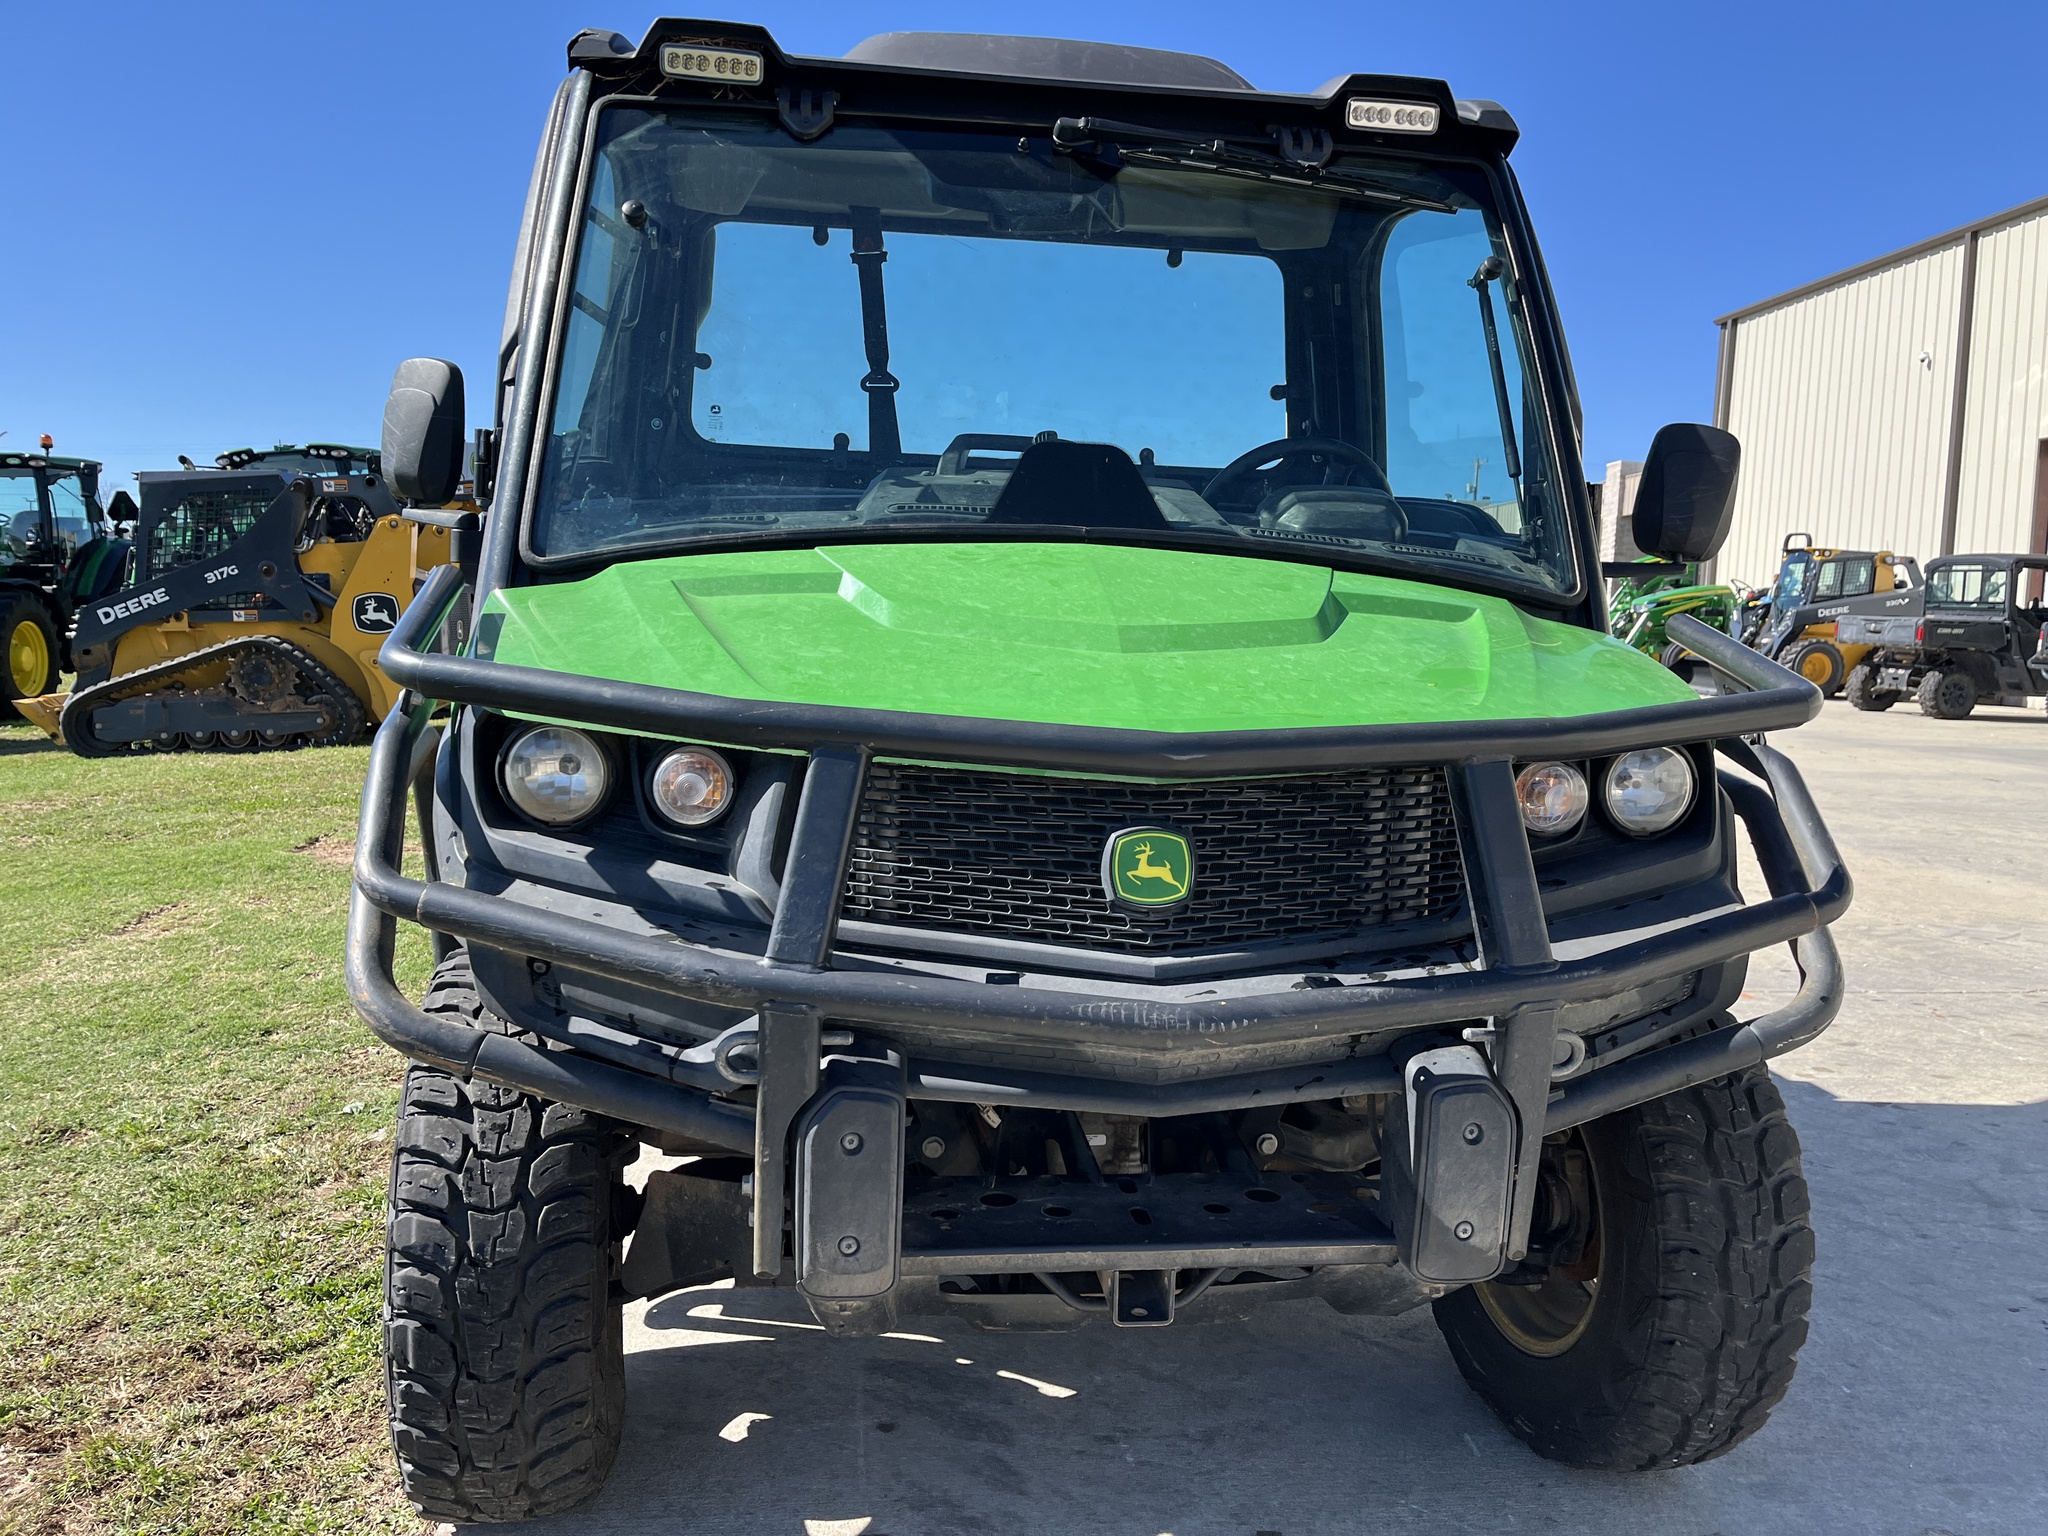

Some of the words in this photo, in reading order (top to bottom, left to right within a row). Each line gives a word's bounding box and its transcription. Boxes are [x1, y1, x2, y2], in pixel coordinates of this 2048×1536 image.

[204, 565, 239, 584] 317G
[96, 587, 170, 625] DEERE
[1817, 606, 1850, 618] DEERE
